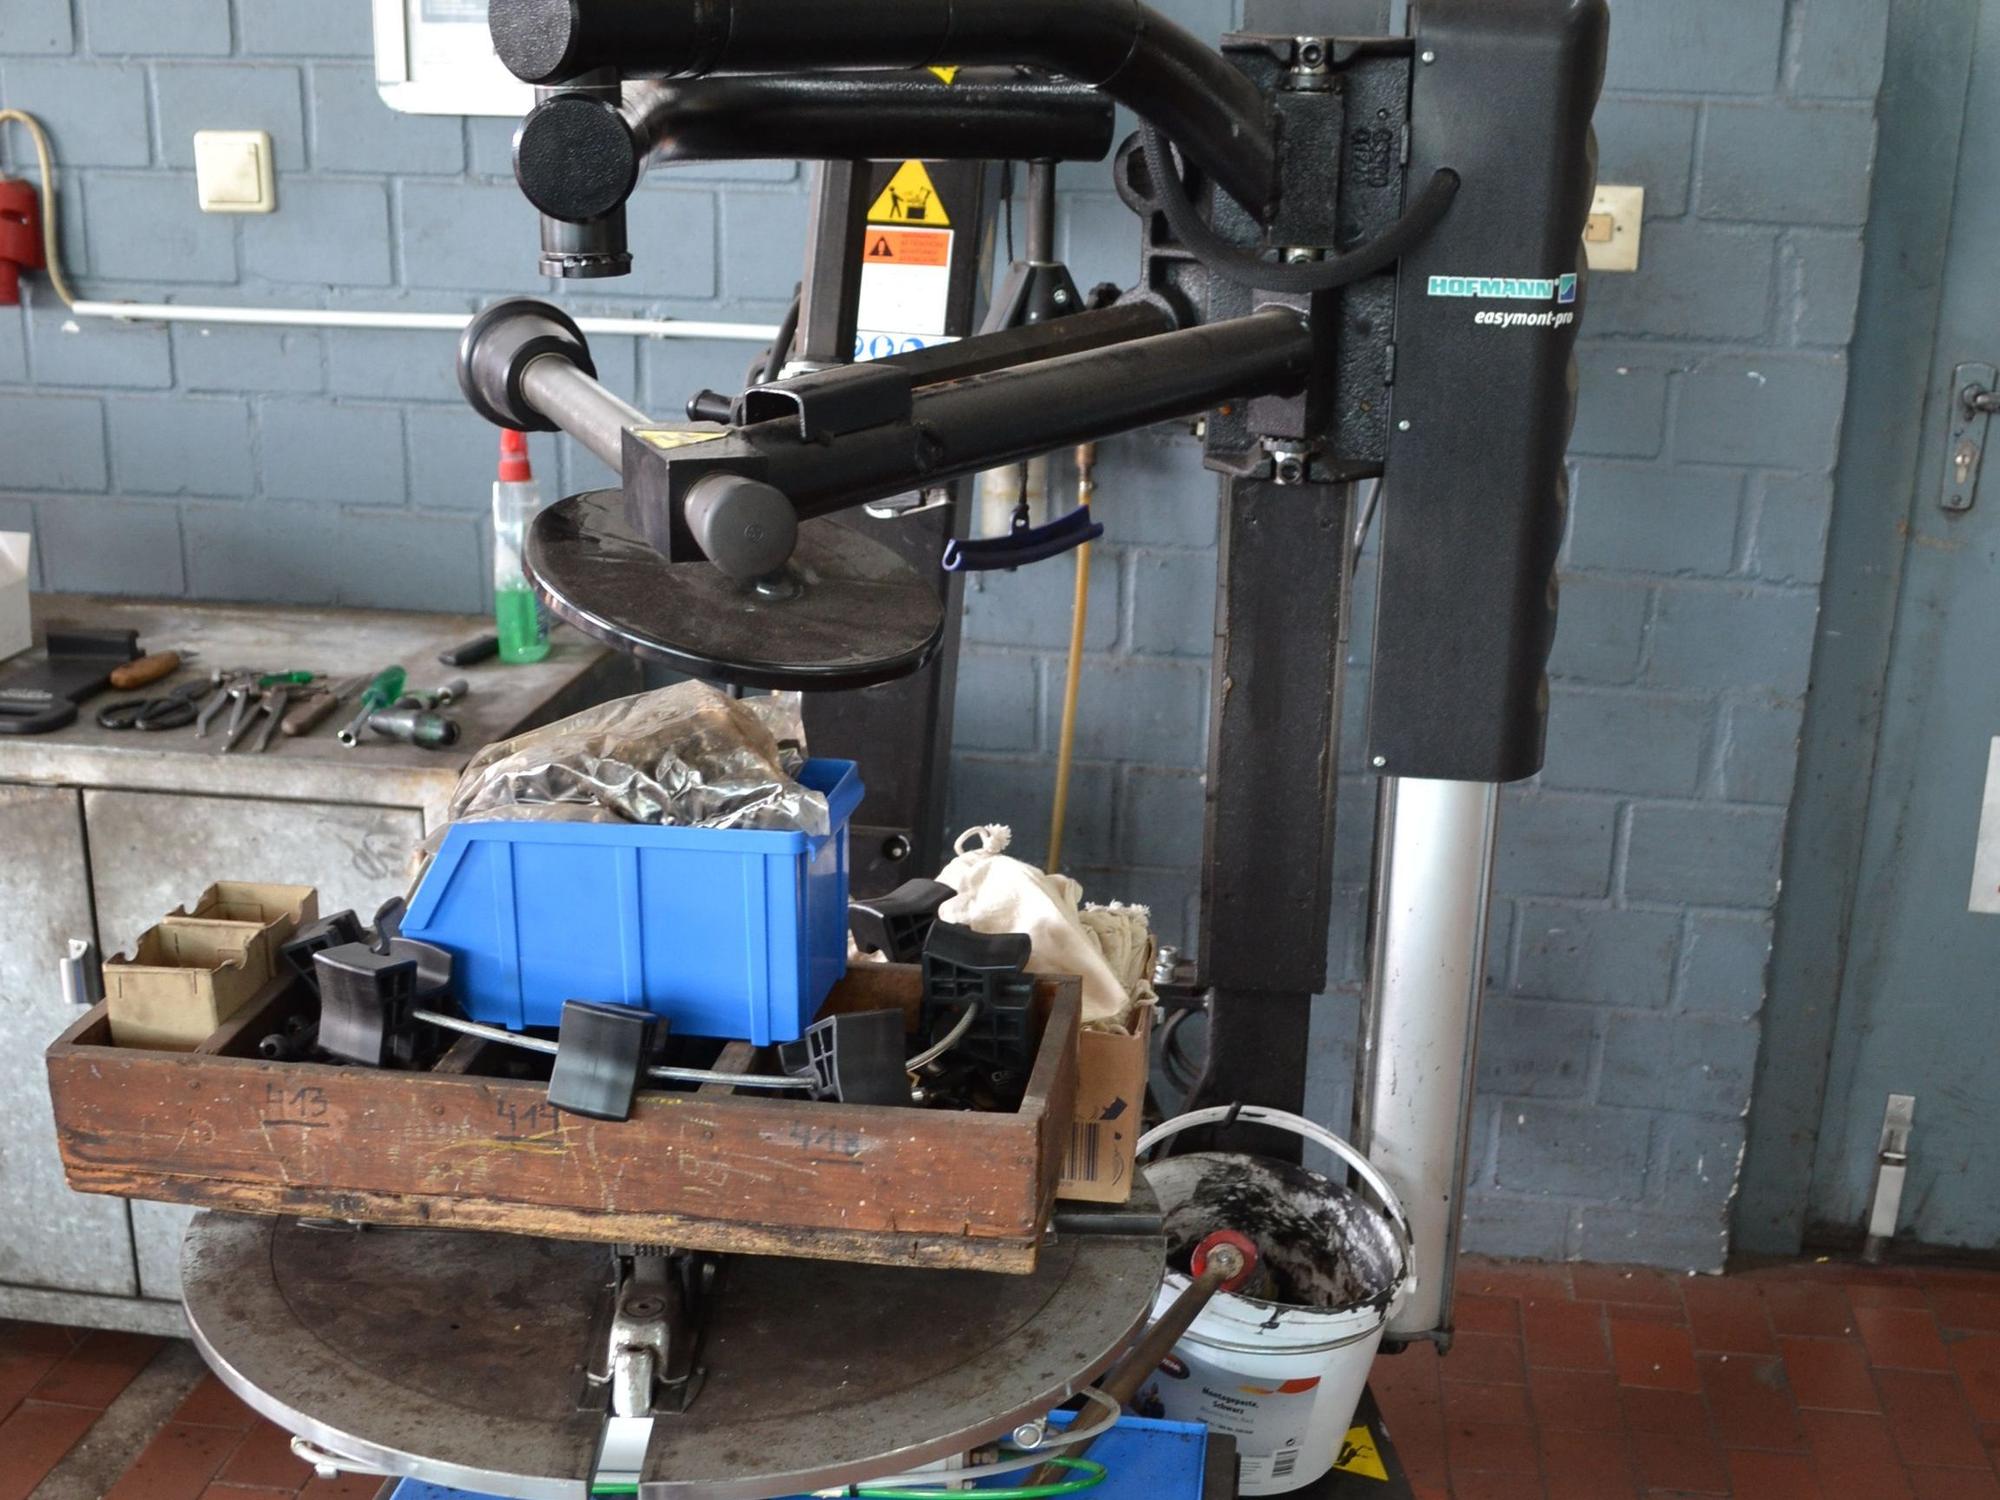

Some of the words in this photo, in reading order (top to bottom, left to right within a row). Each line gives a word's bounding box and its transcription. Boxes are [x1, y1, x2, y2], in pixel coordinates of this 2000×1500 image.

[1428, 276, 1554, 299] HOFMANN
[1474, 311, 1574, 328] easymont-pro
[265, 1083, 328, 1118] 413
[497, 1097, 560, 1133] 414
